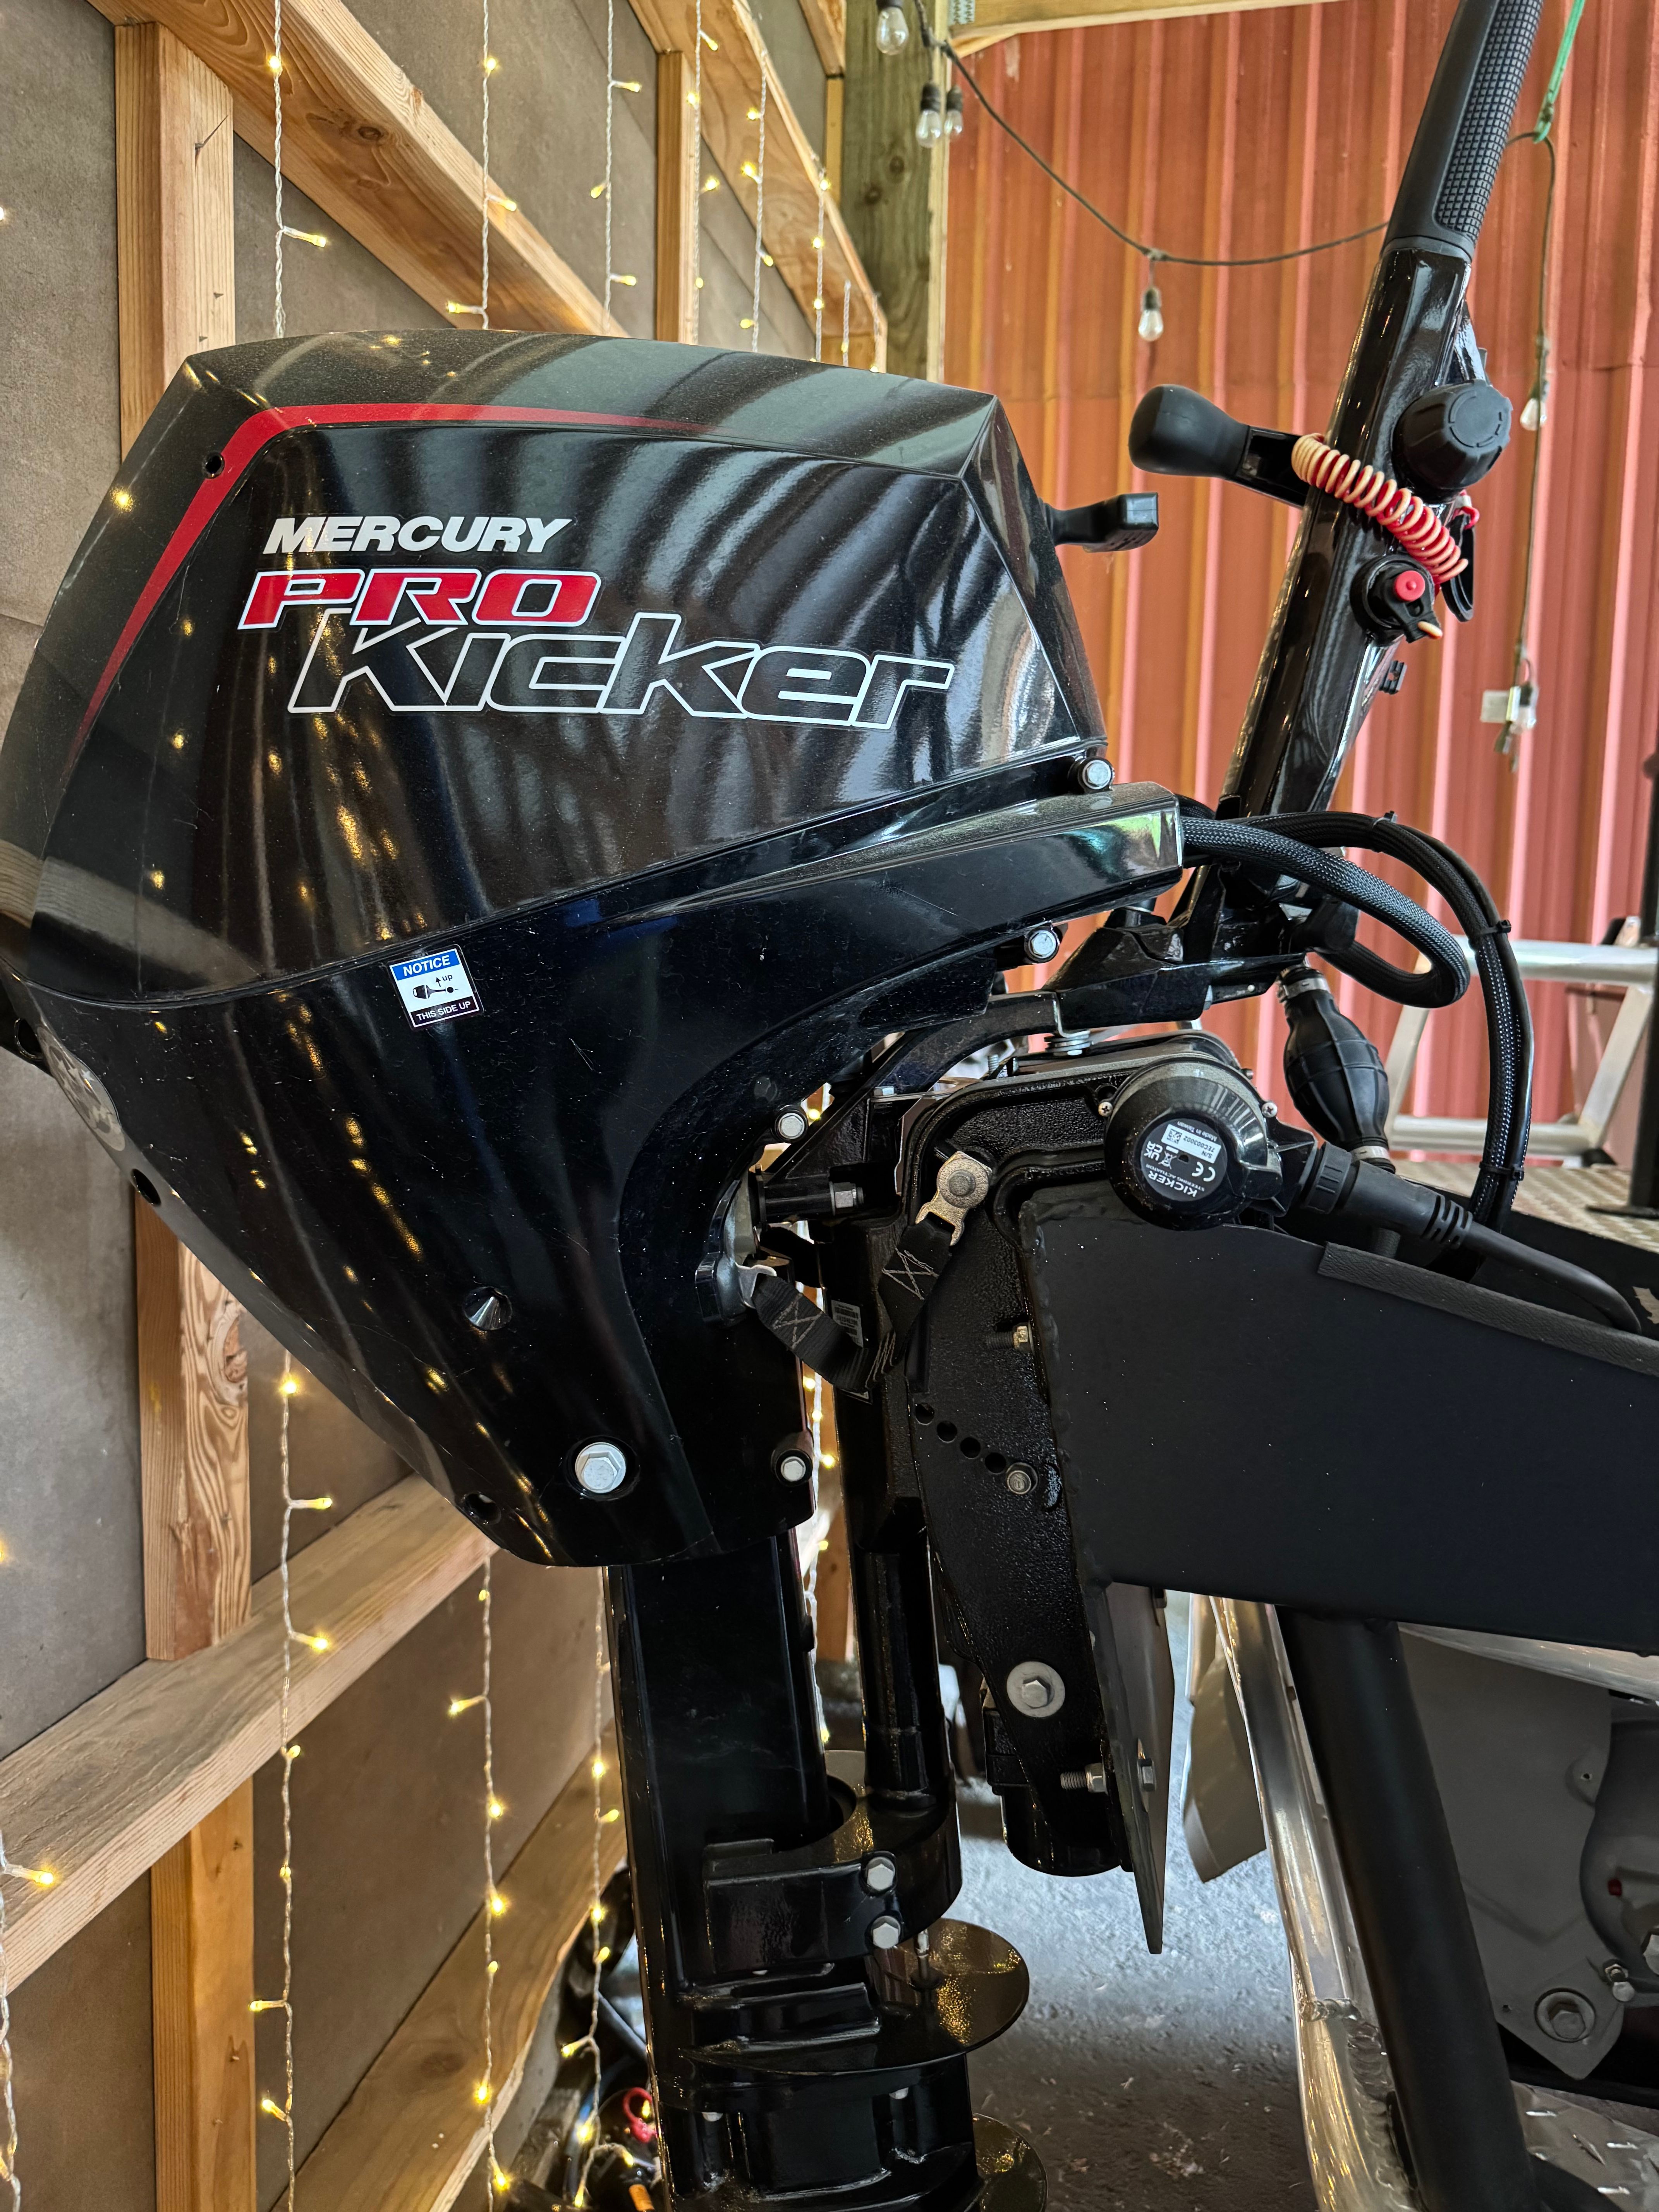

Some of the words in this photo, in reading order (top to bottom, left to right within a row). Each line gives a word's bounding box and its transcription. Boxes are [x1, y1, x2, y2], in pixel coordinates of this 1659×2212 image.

[263, 516, 572, 554] MERCURY
[237, 568, 601, 630] PRO
[287, 607, 955, 730] Kicker
[403, 955, 450, 976] NOTICE
[416, 1010, 436, 1021] THIS
[437, 1005, 458, 1015] SIDE
[459, 1001, 471, 1010] UP
[1177, 1121, 1195, 1133] Taiwan
[1202, 1131, 1218, 1142] Made
[1201, 1151, 1212, 1159] S/N
[1146, 1164, 1176, 1179] ACTUATOR
[1192, 1161, 1216, 1182] CE
[1148, 1170, 1197, 1197] KICKER
[1177, 1176, 1205, 1192] STEERING
